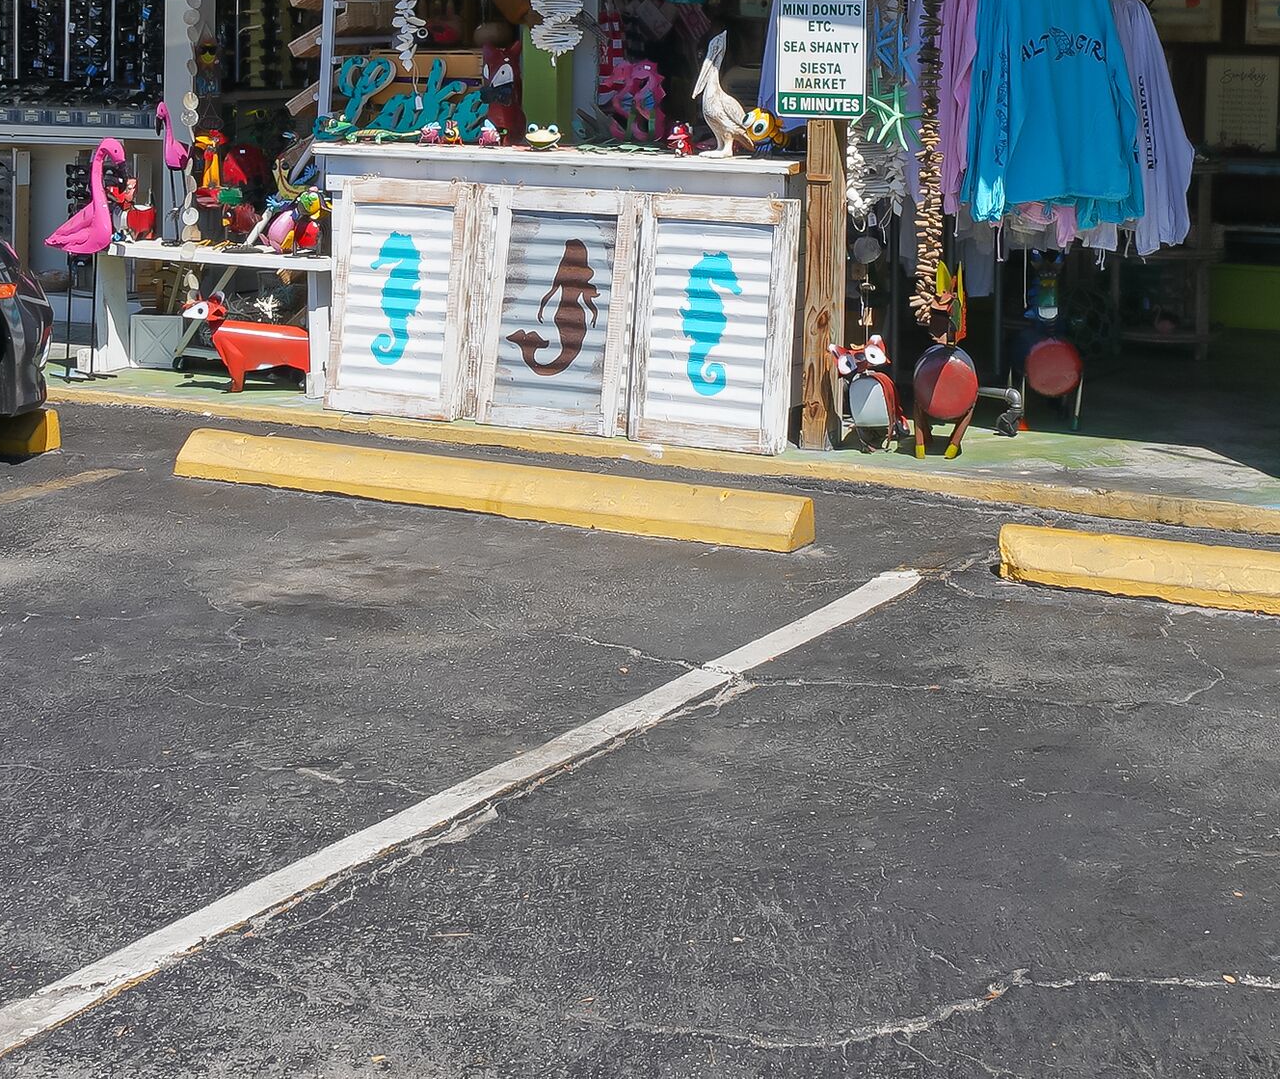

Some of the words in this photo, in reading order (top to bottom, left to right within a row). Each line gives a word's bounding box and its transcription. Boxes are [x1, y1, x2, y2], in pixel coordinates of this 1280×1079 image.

[782, 3, 809, 16] MINI
[812, 4, 861, 17] DONUTS
[808, 21, 835, 33] ETC.
[783, 41, 807, 53] SEA
[810, 42, 860, 54] SHANTY
[799, 62, 842, 75] SIESTA
[794, 78, 847, 90] MARKET
[781, 96, 797, 110] 15
[800, 98, 860, 113] MINUTES
